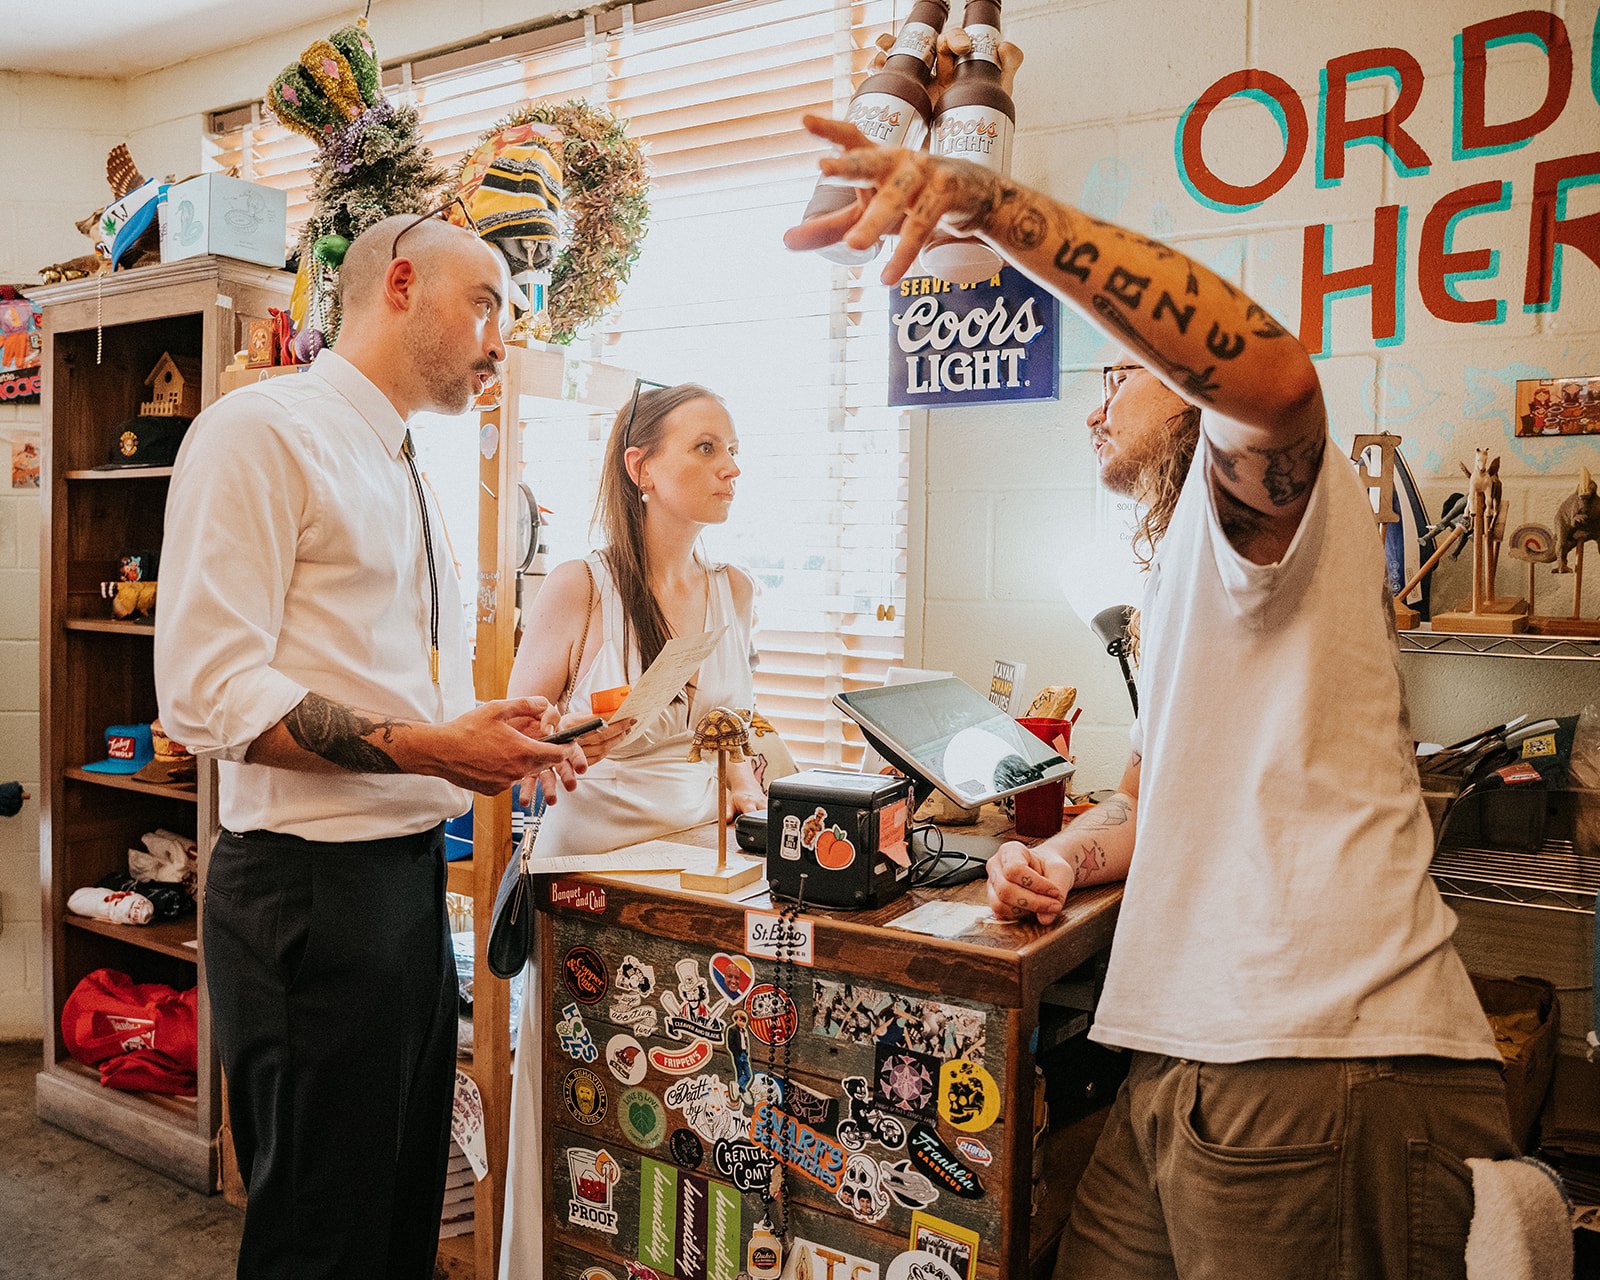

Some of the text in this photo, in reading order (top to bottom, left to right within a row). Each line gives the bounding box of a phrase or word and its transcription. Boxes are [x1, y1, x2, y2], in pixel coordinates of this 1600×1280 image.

[1176, 9, 1600, 213] ORD
[937, 116, 998, 142] Coors
[940, 134, 995, 155] LIGHT
[900, 277, 951, 297] SERVE
[892, 296, 1044, 353] Coors
[906, 347, 1026, 394] LIGHT
[994, 662, 1015, 682] KAYAK
[991, 677, 1013, 696] SWAMP
[989, 692, 1010, 712] TOURS
[552, 882, 581, 904] Banquet
[575, 889, 606, 910] and Chill
[574, 968, 597, 994] Kings
[577, 957, 604, 986] Copper
[663, 1050, 702, 1068] FRIPPER'S
[912, 1131, 974, 1191] Franklin
[917, 1150, 962, 1192] BARBECUE
[571, 1203, 615, 1227] PROOF
[645, 1167, 672, 1264] humidity
[676, 1179, 703, 1278] humidity
